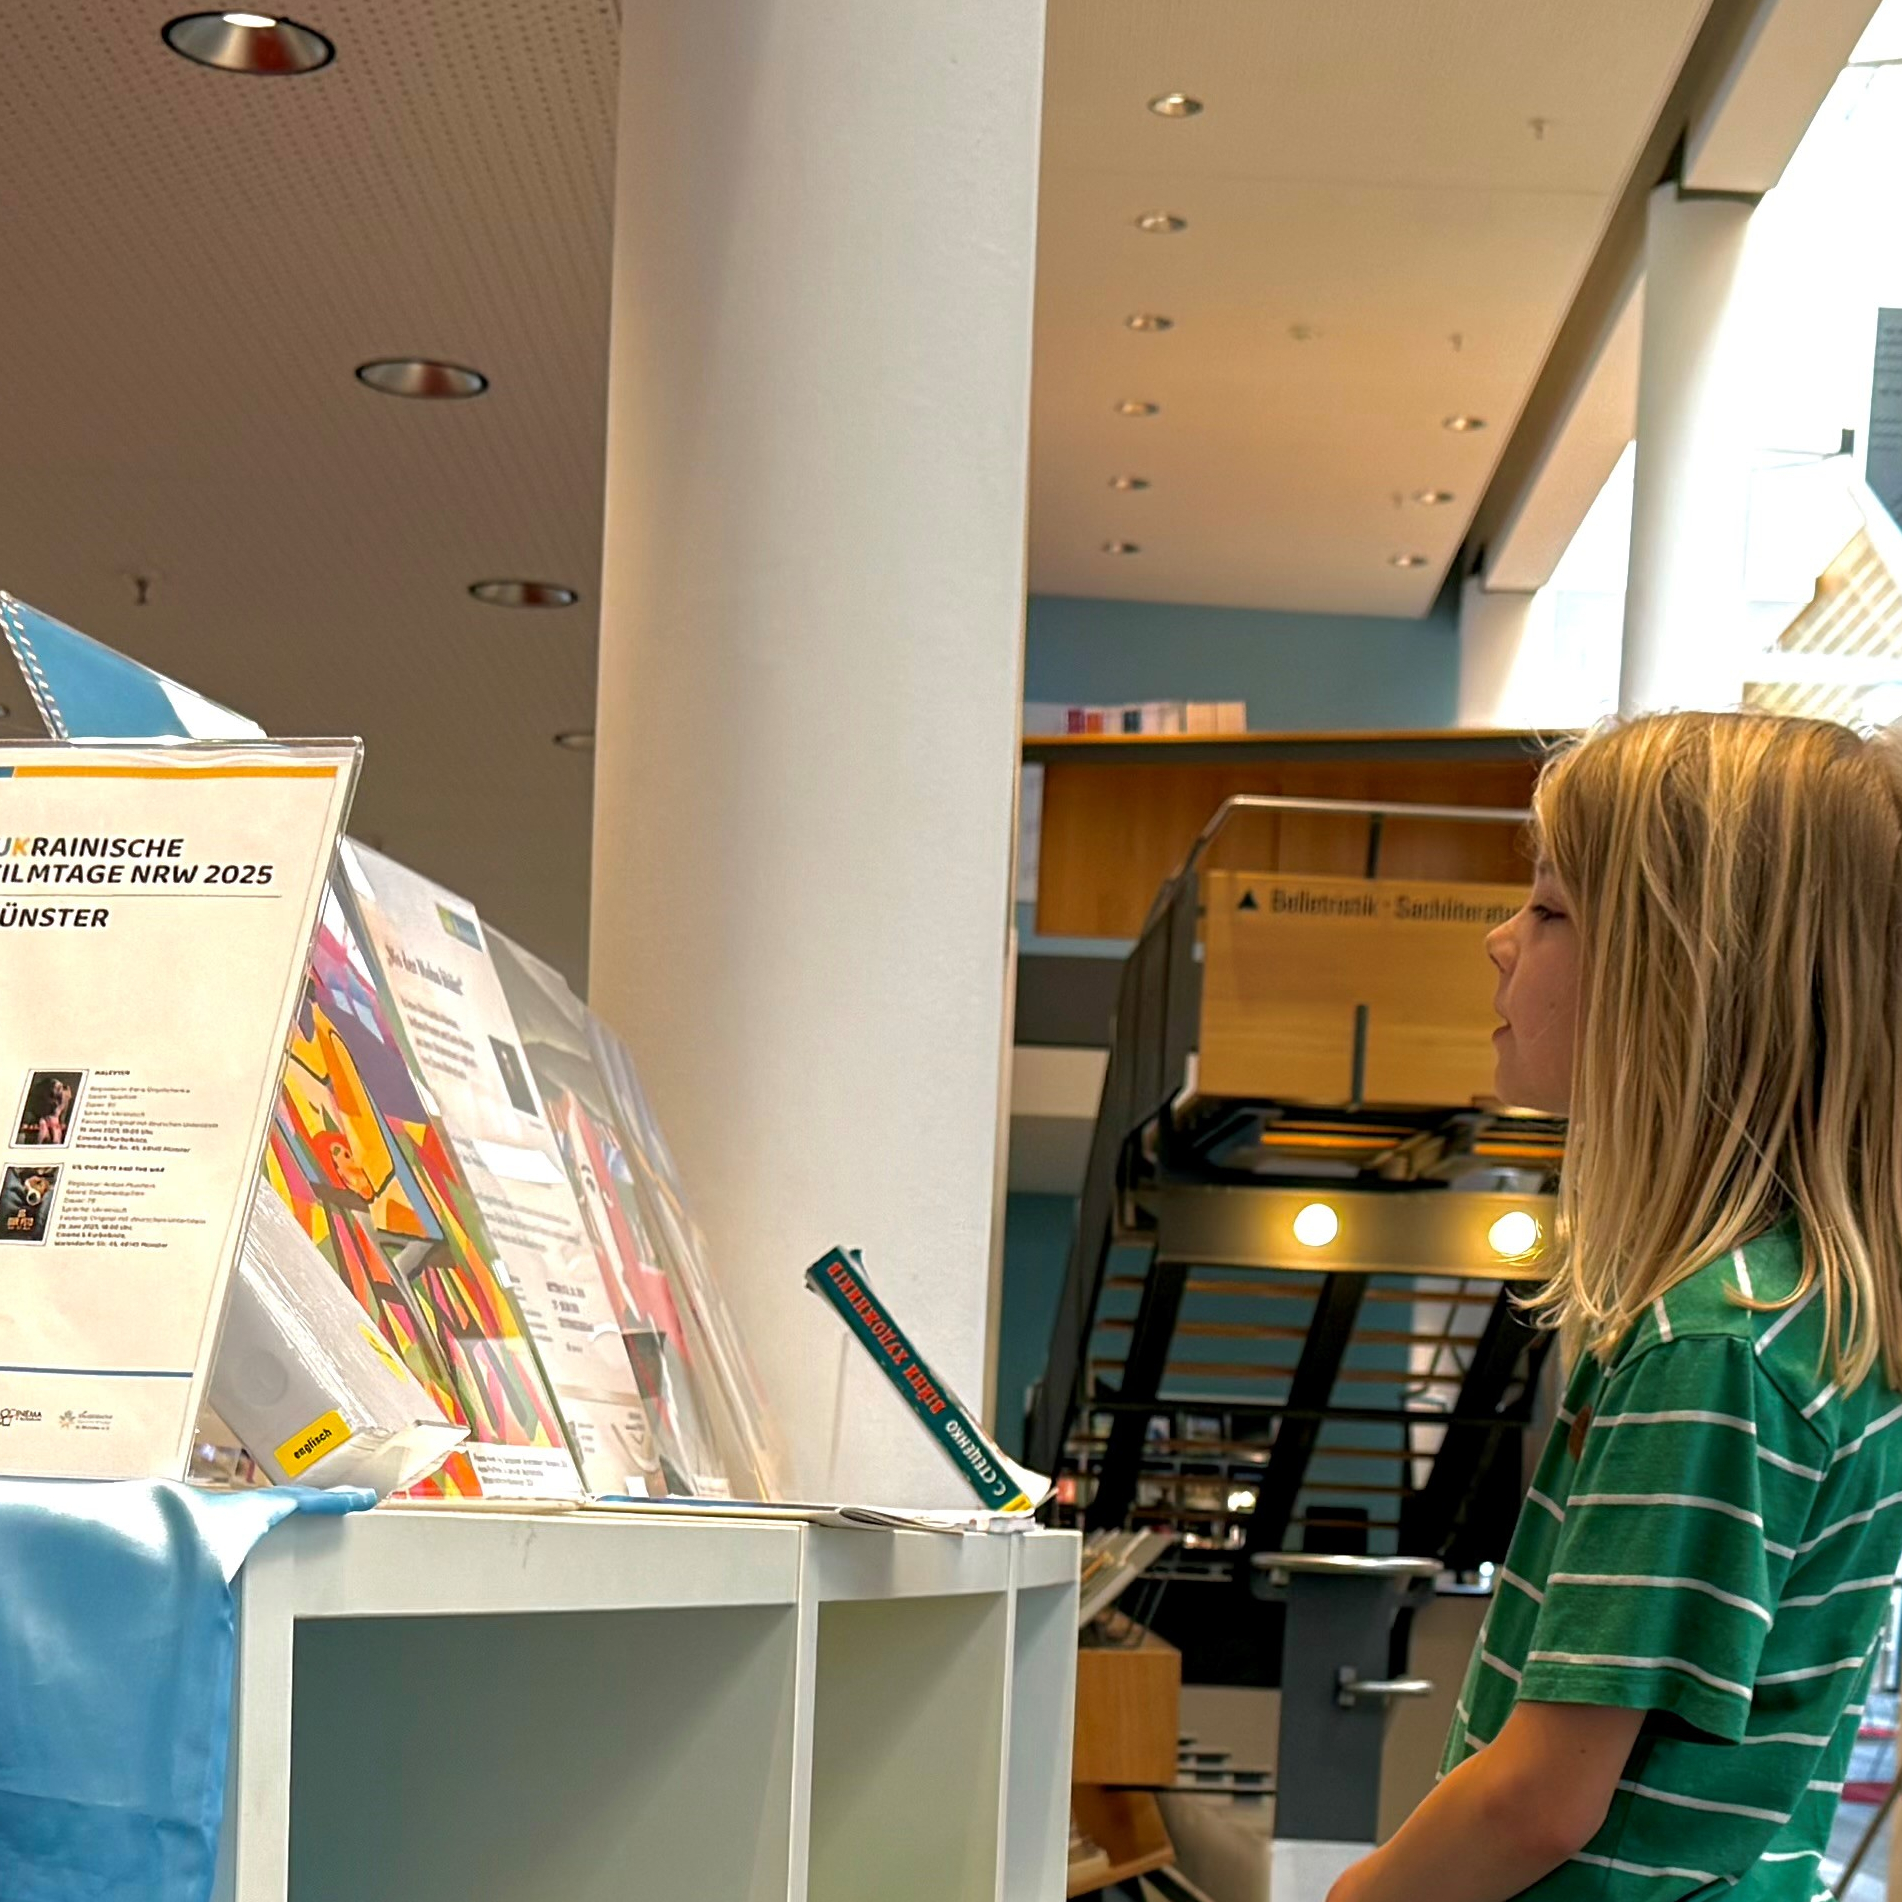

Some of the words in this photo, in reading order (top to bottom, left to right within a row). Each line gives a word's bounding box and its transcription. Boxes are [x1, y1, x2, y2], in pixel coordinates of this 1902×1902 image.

[129, 864, 198, 885] NRW
[202, 864, 274, 885] 2025
[827, 1260, 910, 1367] ХУДОЖНИКІВ
[902, 1362, 947, 1416] ВІЙНИ
[293, 1428, 333, 1460] englisch
[945, 1420, 997, 1484] СТЕЦЕНКО
